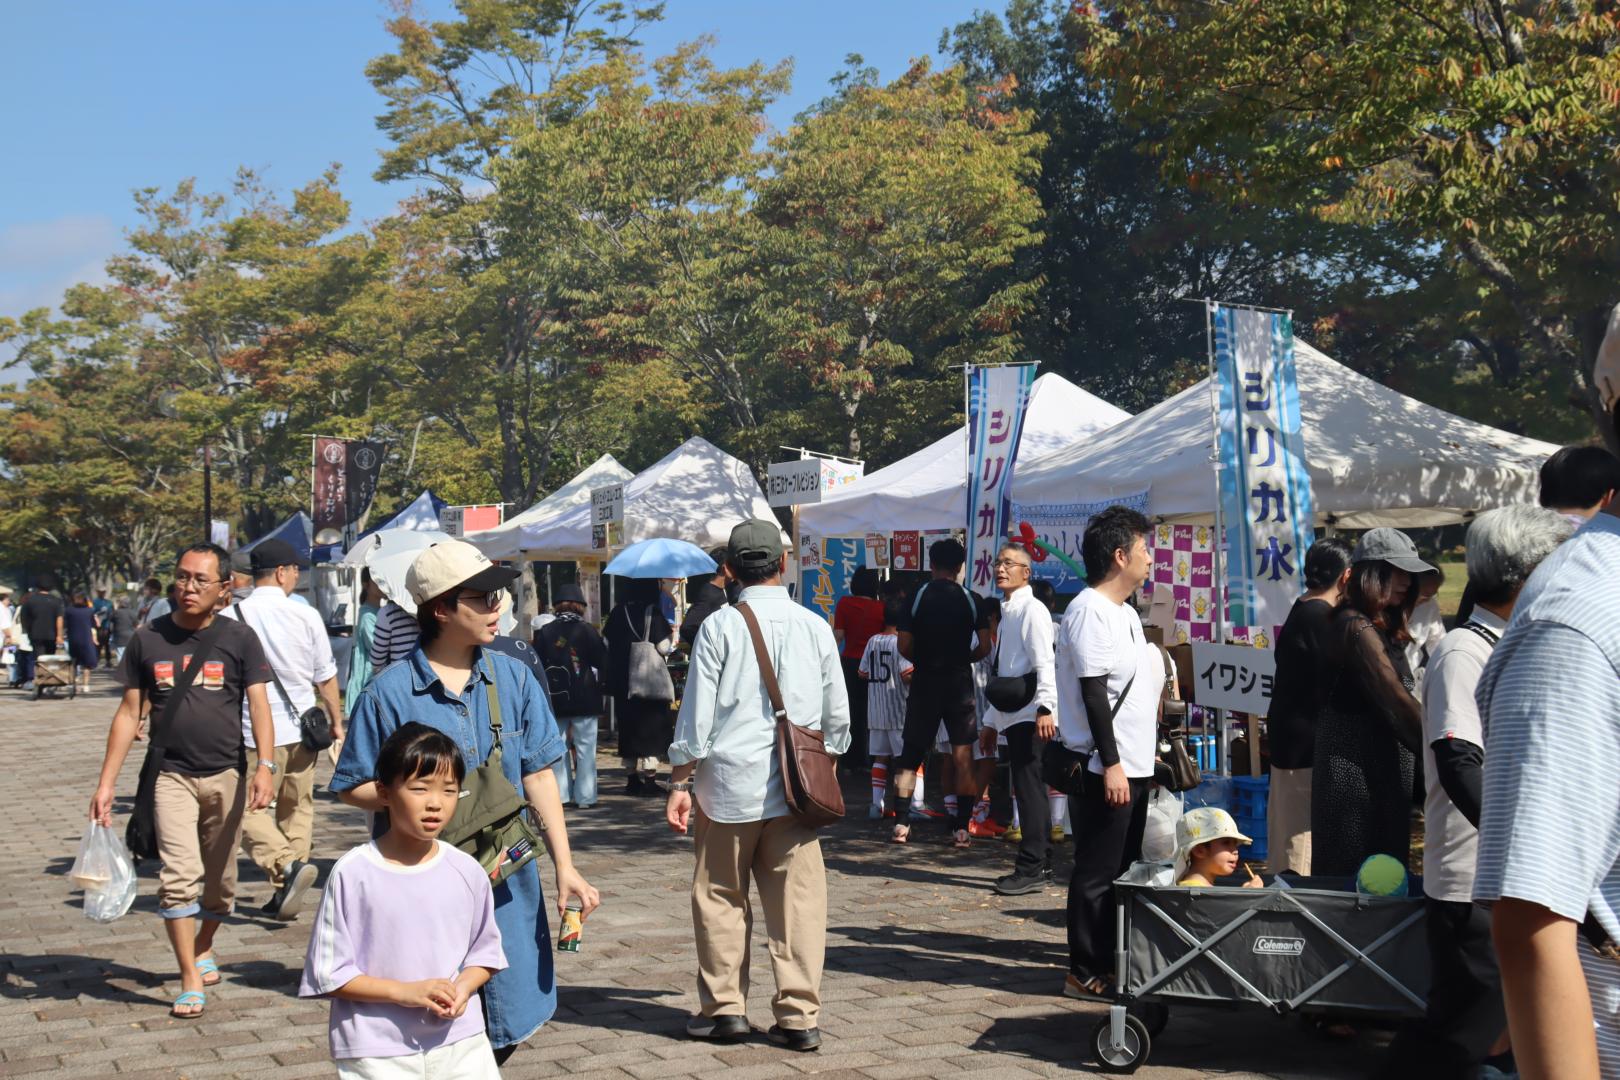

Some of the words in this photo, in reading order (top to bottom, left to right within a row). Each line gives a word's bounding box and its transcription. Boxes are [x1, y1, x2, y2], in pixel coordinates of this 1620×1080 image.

[973, 409, 1011, 587] シリカ水
[1244, 371, 1296, 582] シリカ水
[867, 650, 892, 684] 15
[1257, 938, 1295, 951] Coleman
